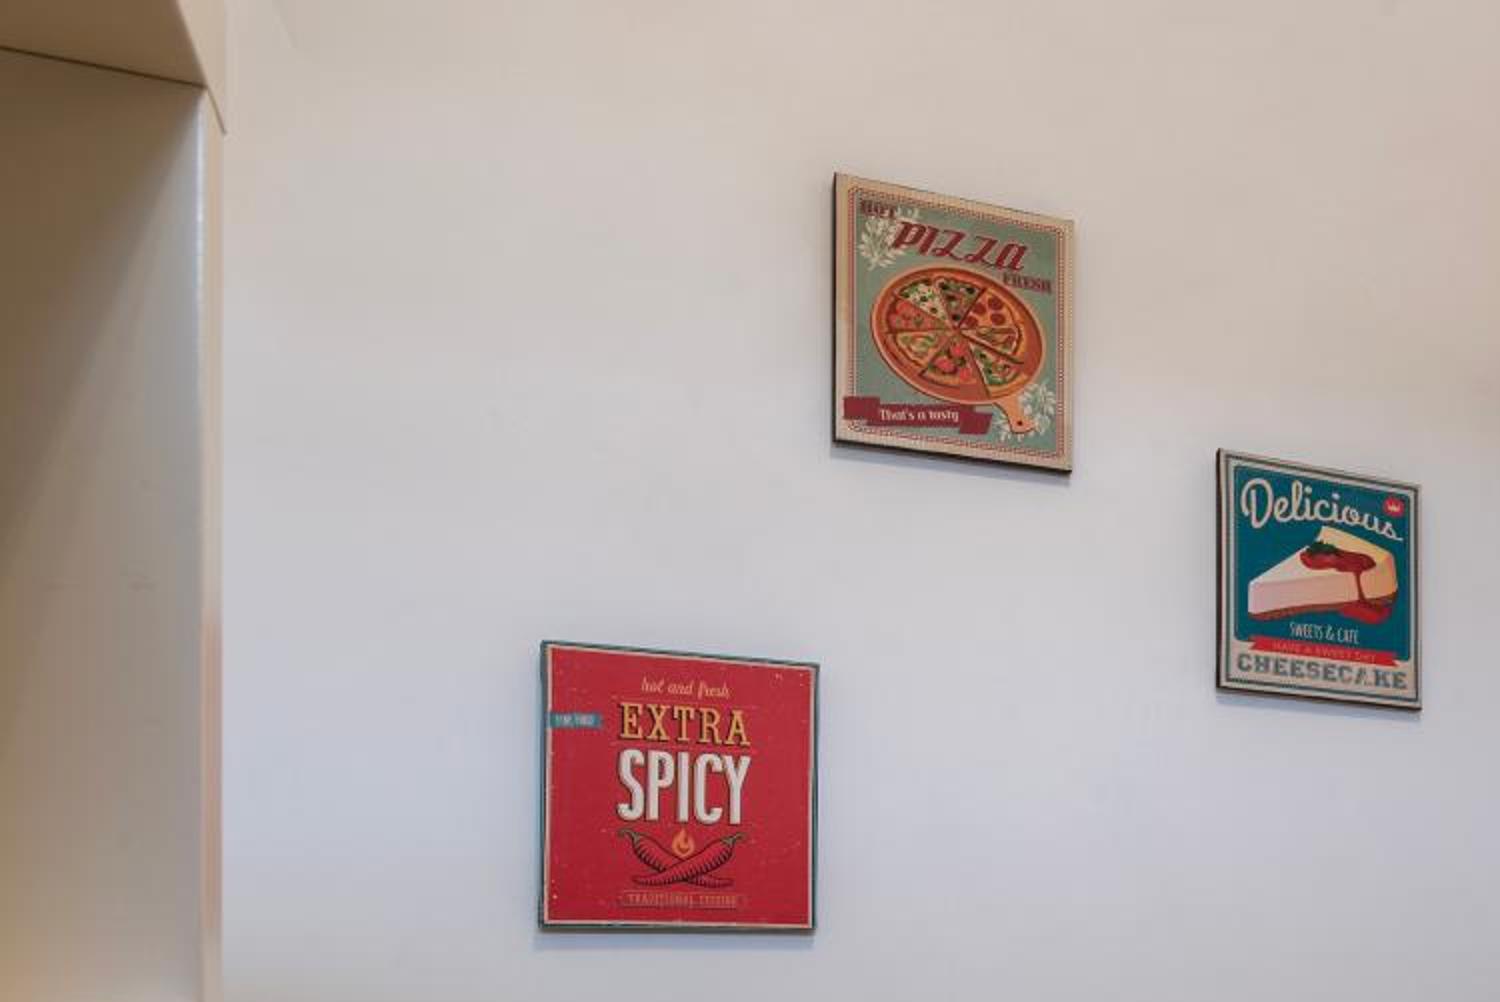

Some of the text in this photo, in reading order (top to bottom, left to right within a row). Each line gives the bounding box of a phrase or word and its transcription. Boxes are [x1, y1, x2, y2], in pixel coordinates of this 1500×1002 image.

[892, 220, 1027, 271] PIZZA
[1002, 271, 1051, 294] FRESH
[881, 408, 960, 423] That's a tasty
[1240, 477, 1404, 542] Delicious
[1289, 621, 1322, 640] SWEETS
[1325, 623, 1335, 641] &
[641, 676, 731, 700] hot and fresh
[1236, 652, 1408, 690] CHEESECAKE
[619, 701, 751, 747] EXTRA
[616, 748, 751, 826] SPICY
